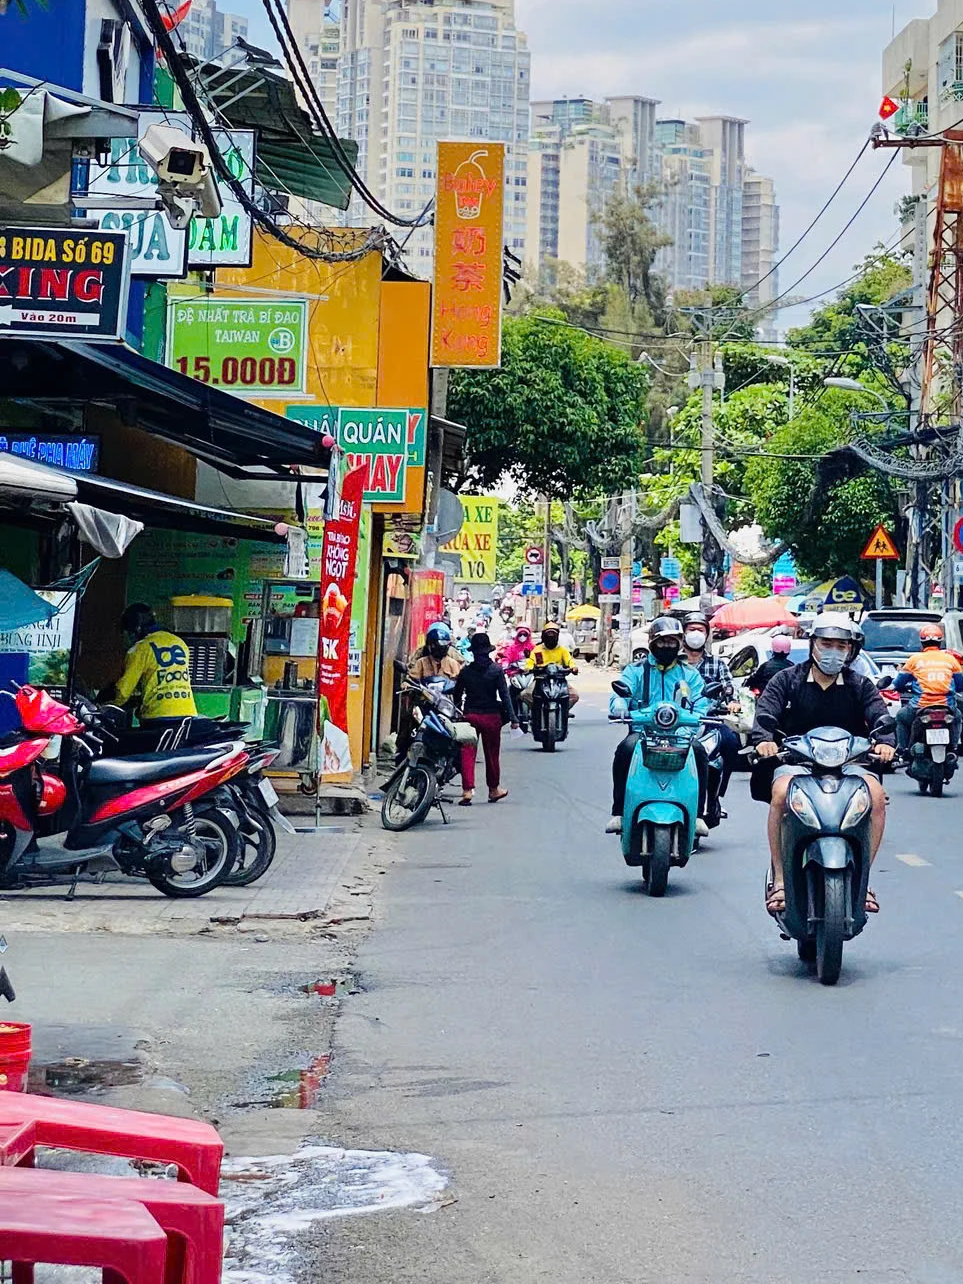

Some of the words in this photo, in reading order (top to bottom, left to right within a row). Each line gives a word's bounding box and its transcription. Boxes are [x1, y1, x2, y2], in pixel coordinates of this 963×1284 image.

[12, 237, 57, 262] BIDA
[91, 241, 115, 264] 69
[21, 312, 45, 321] Vào
[48, 314, 77, 323] 20m
[177, 307, 194, 325] ĐỆ
[198, 307, 229, 322] NHẤT
[233, 308, 255, 323] TRÀ
[259, 308, 271, 324] BÍ
[274, 312, 300, 324] ĐAO
[215, 330, 260, 344] TAIWAN
[176, 356, 296, 385] 15.000Đ
[343, 416, 402, 444] QUÁN
[474, 506, 493, 522] XE
[474, 533, 491, 551] XE
[327, 544, 349, 561] KHÔNG
[326, 558, 348, 581] NGỌT
[832, 588, 857, 602] be
[149, 642, 187, 667] be
[157, 667, 188, 685] Food
